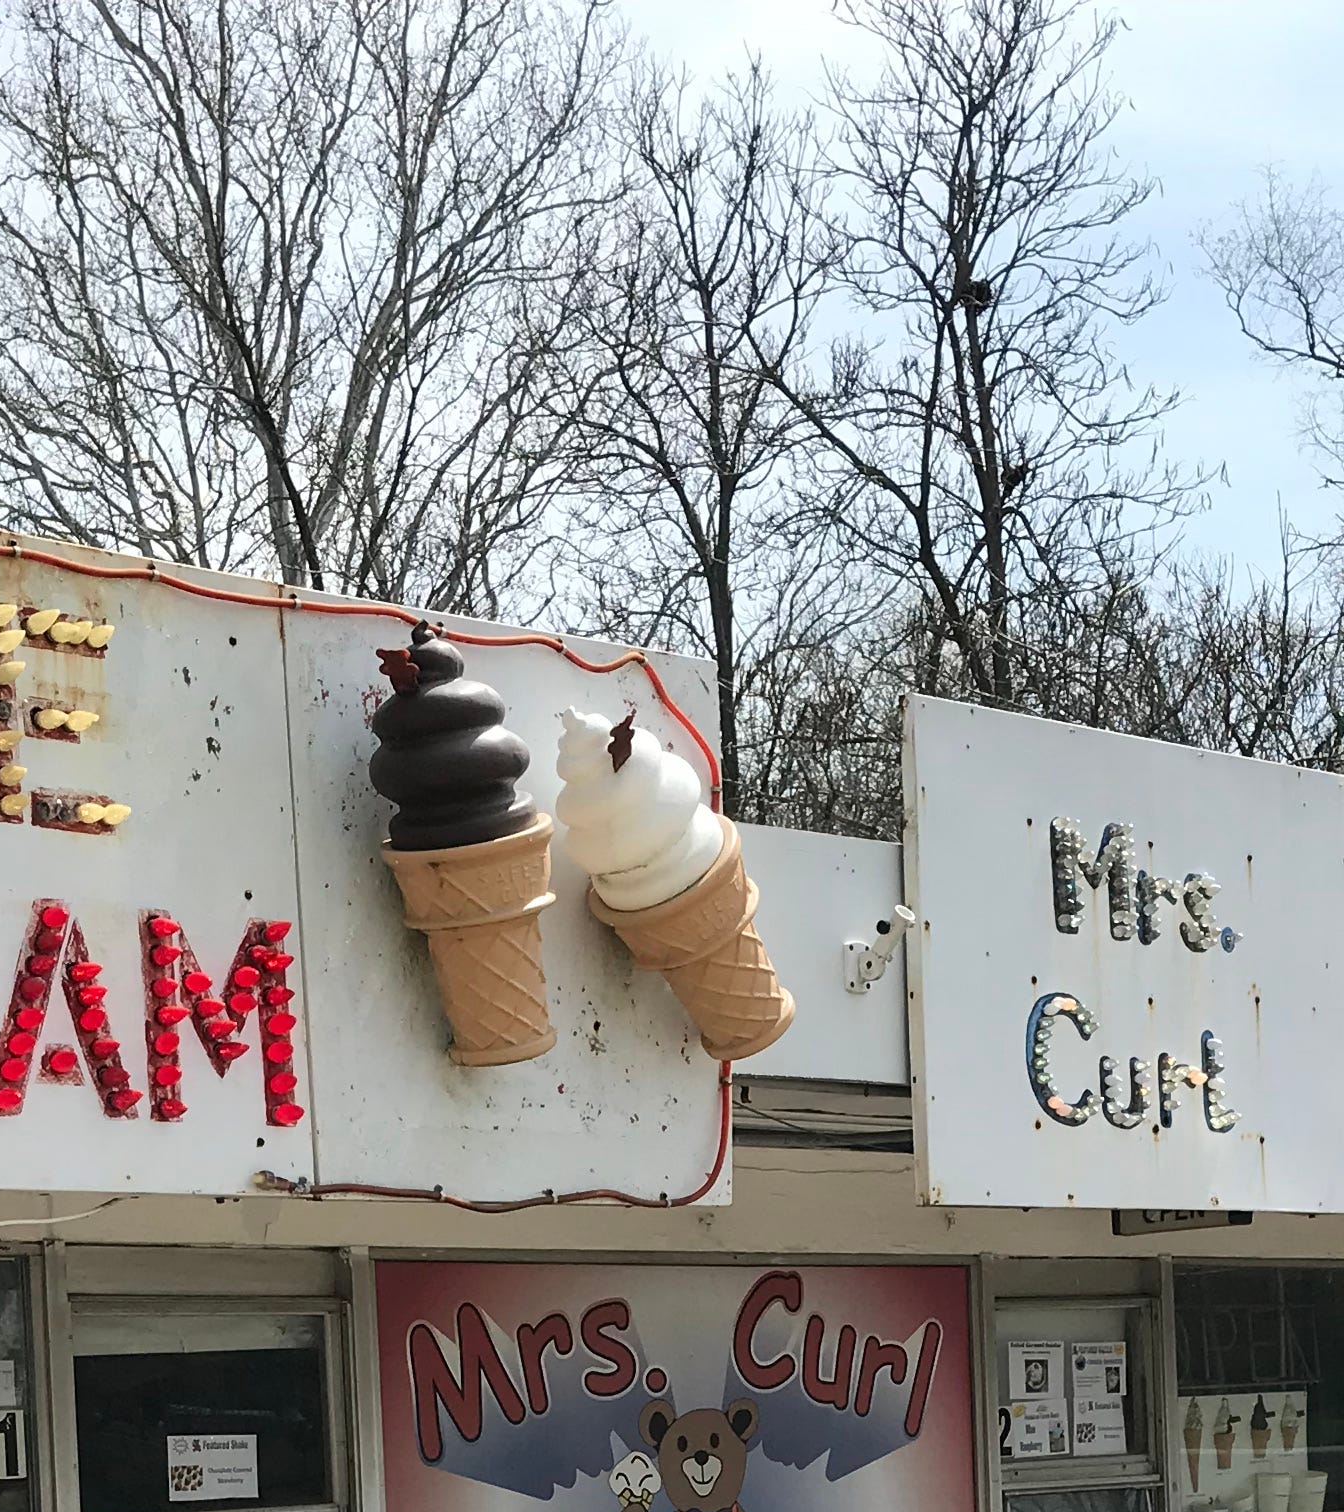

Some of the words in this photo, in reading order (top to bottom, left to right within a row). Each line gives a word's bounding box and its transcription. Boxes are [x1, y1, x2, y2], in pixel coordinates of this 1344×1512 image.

[1051, 814, 1243, 953] Mrs.
[407, 1302, 668, 1465] Mrs.
[733, 1270, 943, 1438] Curl
[998, 1408, 1012, 1456] 2
